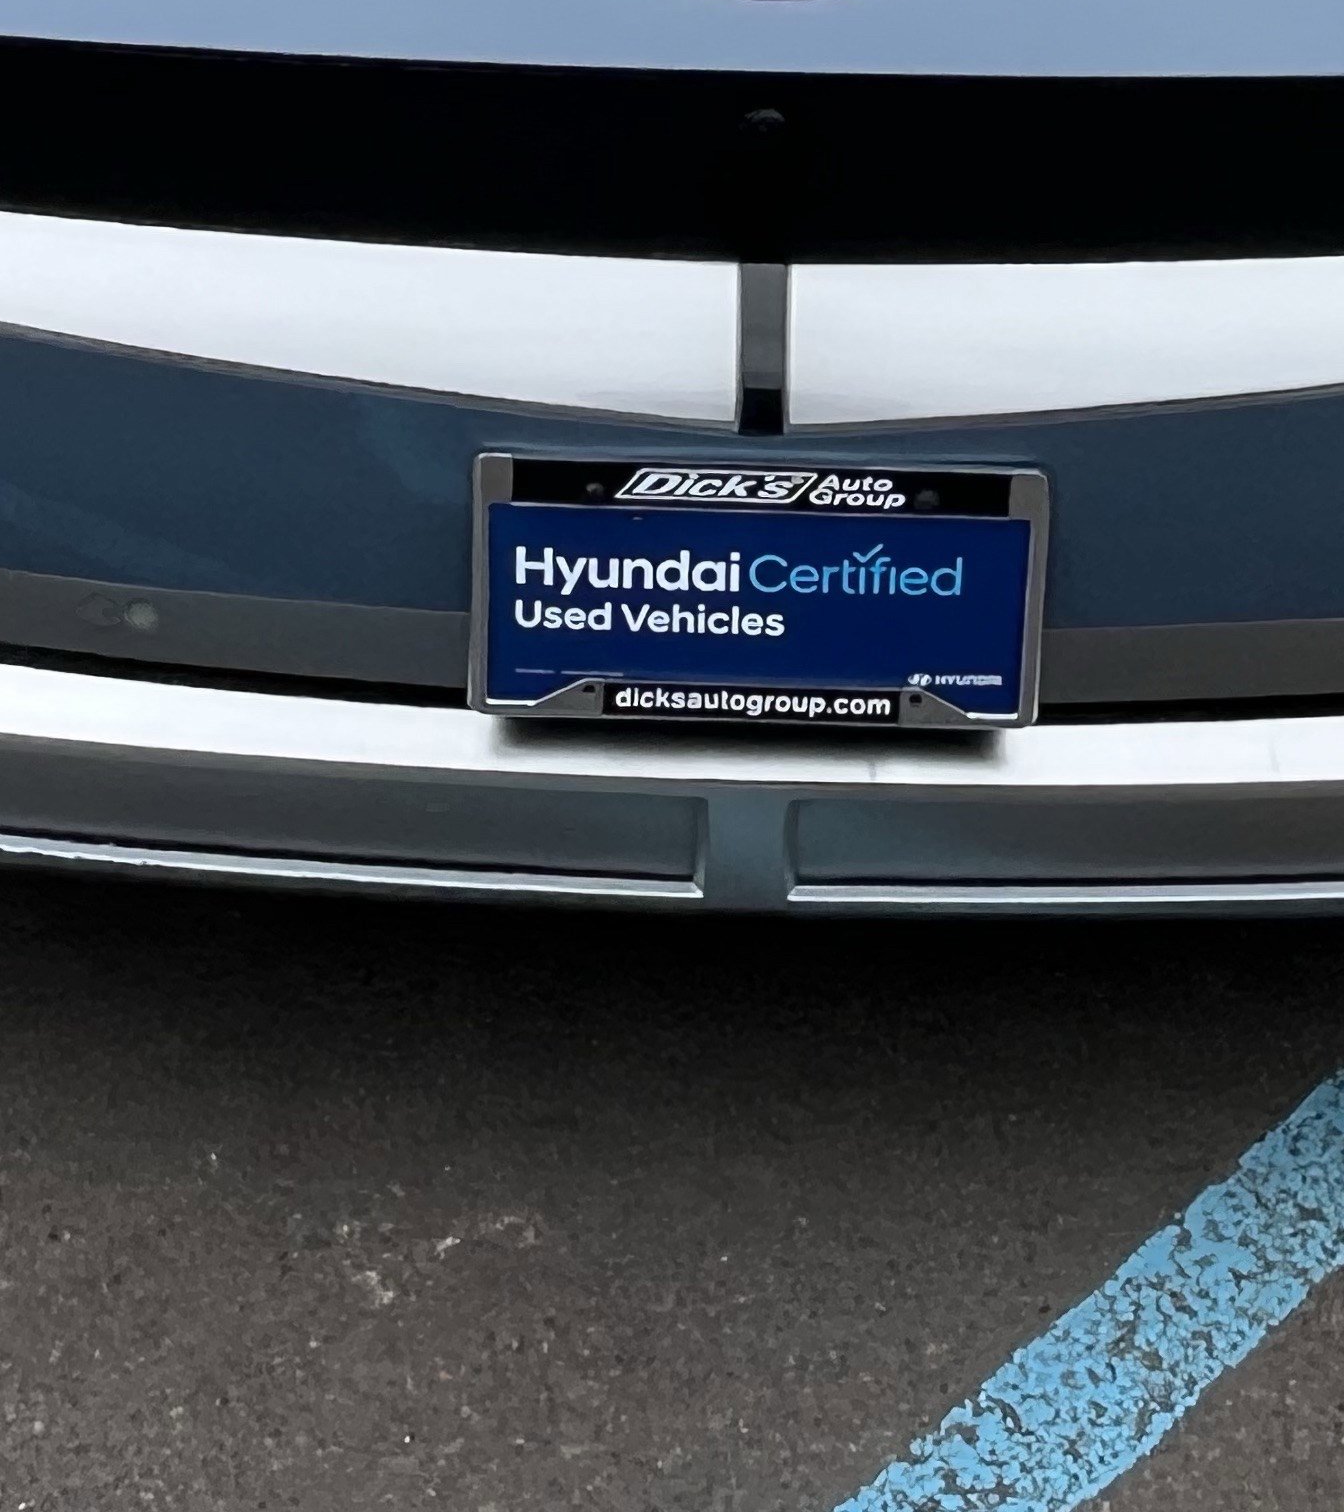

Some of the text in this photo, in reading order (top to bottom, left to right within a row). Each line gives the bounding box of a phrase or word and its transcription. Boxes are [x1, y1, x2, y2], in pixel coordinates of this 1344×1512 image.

[818, 475, 894, 492] Auto
[809, 489, 905, 510] Group
[515, 544, 962, 596] Hyundai Certified
[514, 600, 785, 636] Used Vehicles
[615, 689, 891, 718] dicksautogroup.com
